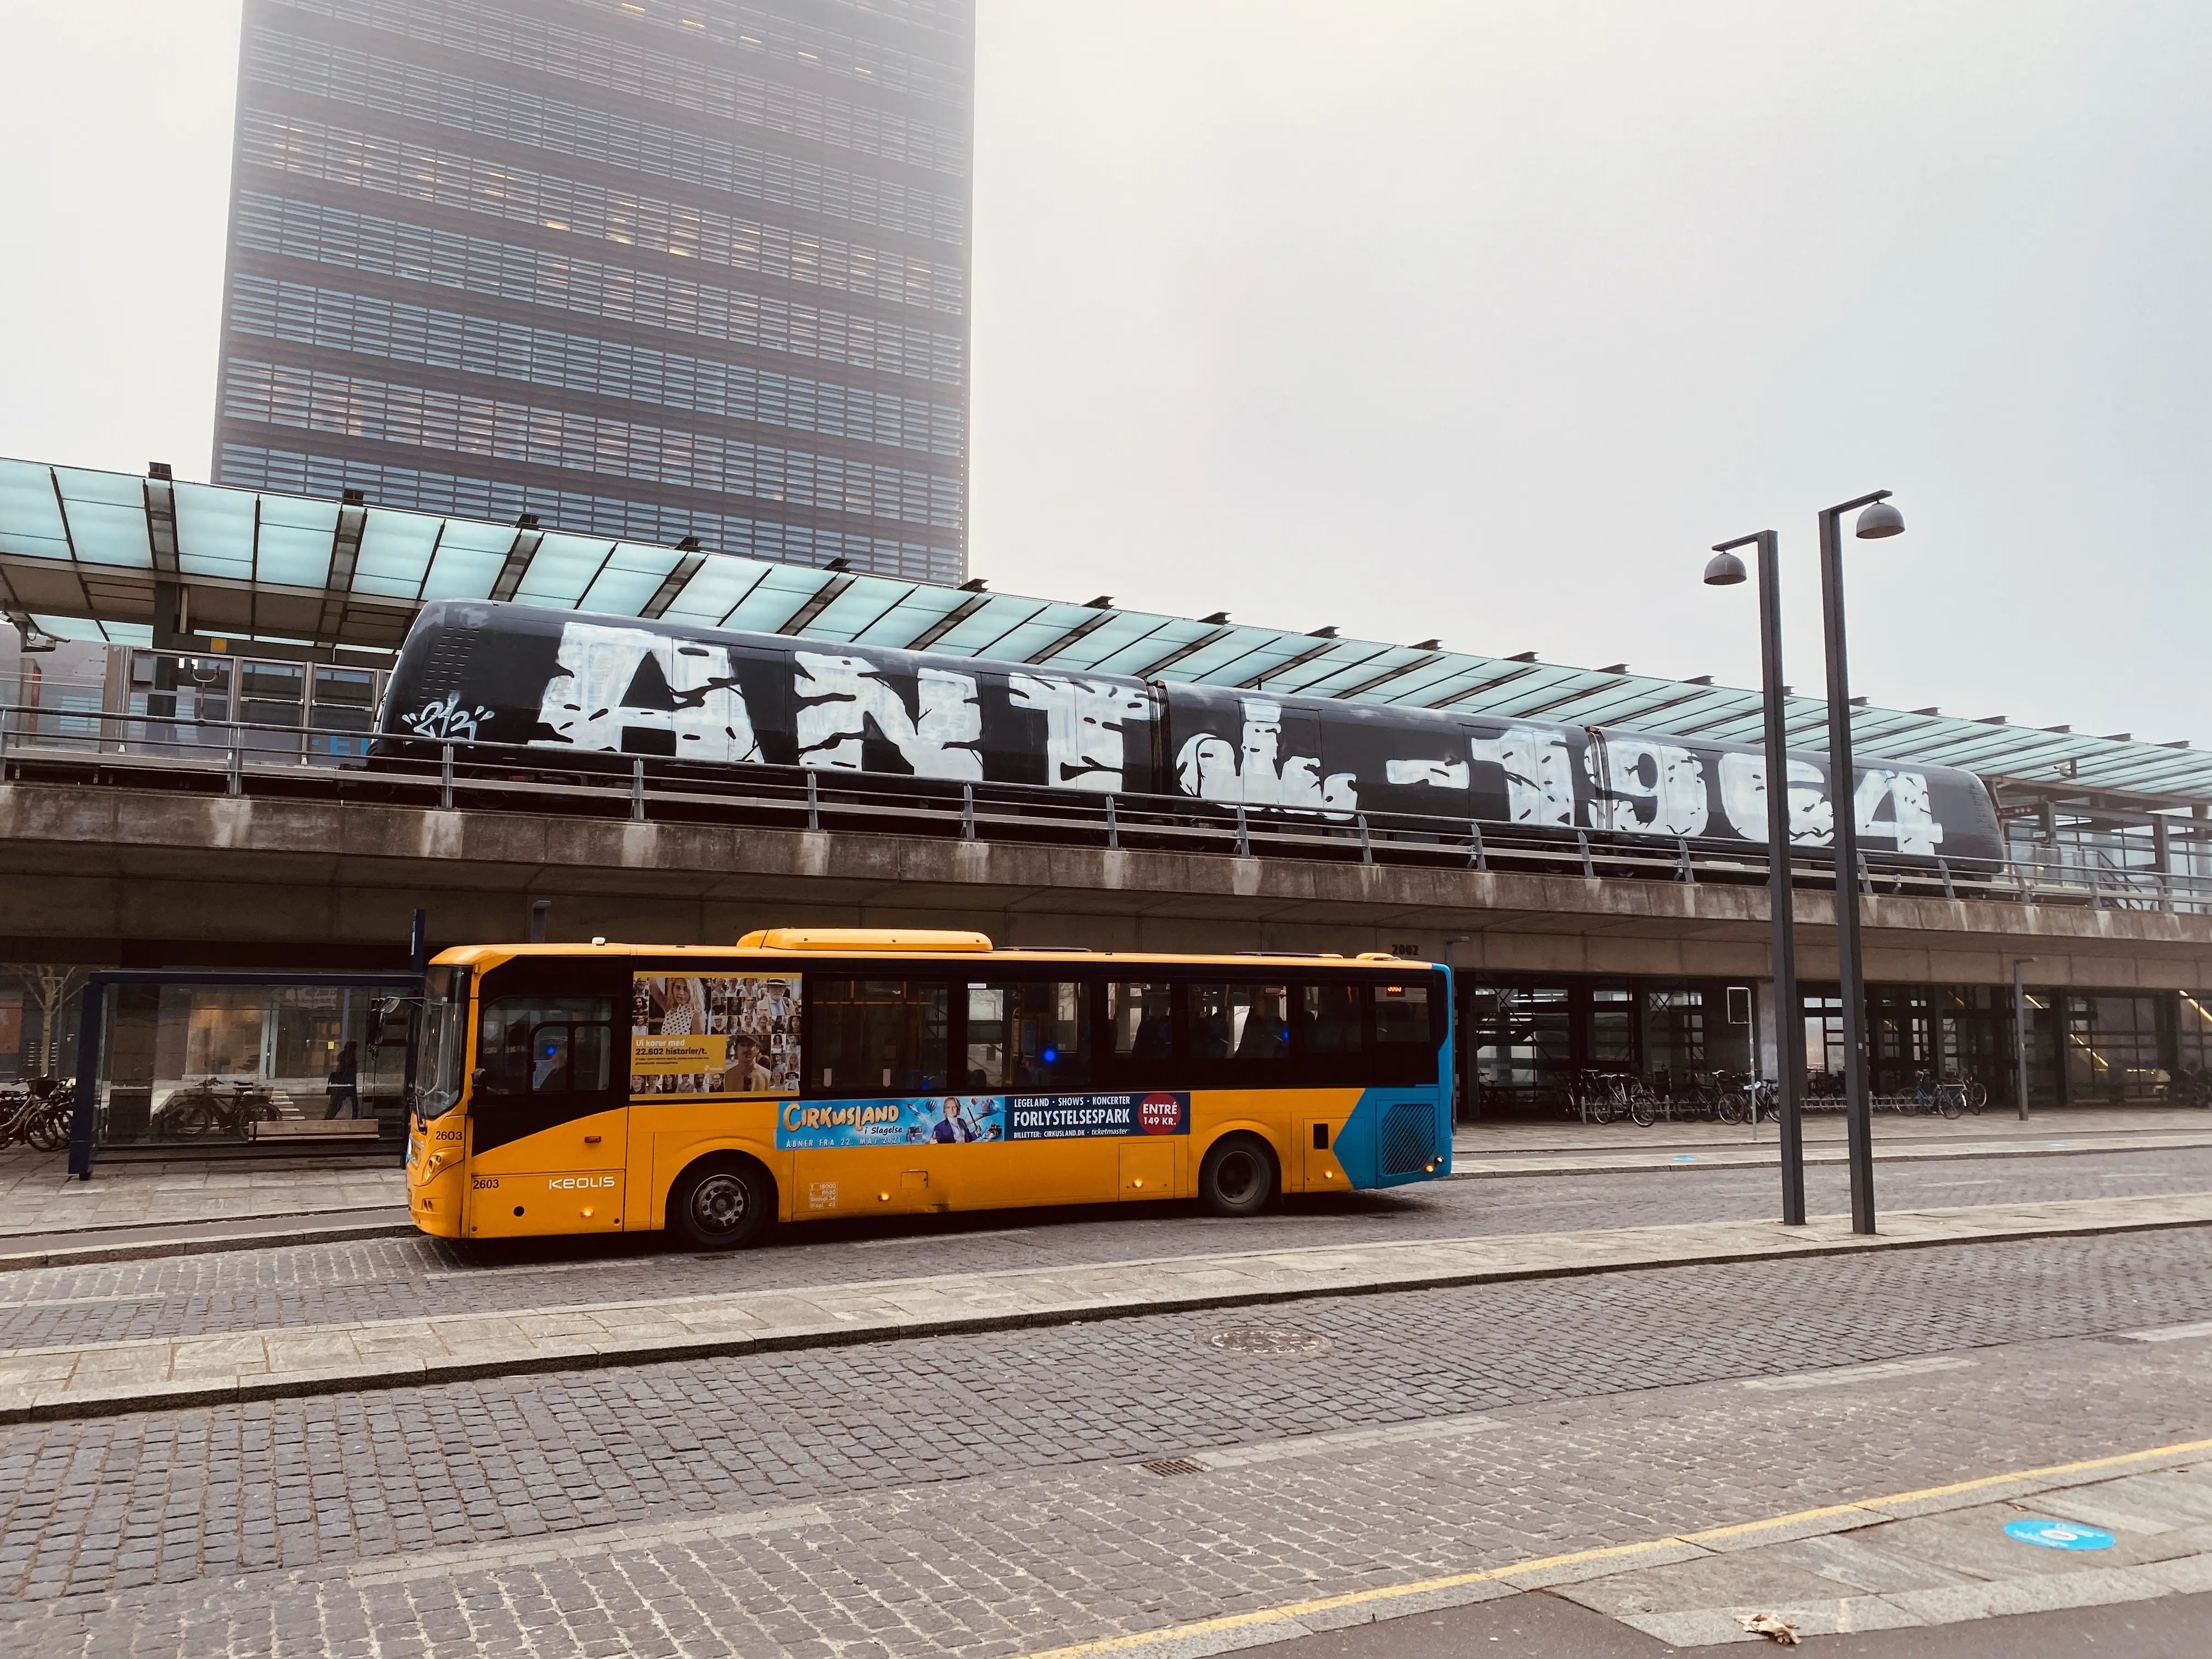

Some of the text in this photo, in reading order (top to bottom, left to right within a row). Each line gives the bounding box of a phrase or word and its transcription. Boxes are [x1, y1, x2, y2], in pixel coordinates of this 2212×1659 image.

[665, 1047, 707, 1056] historier/t.
[1014, 1096, 1130, 1108] LEGELAND SHOWS KONCERTER
[1142, 1101, 1178, 1115] ENTRÉ
[1014, 1108, 1131, 1127] FORLYSTELSESPARK
[1143, 1116, 1176, 1125] 149 KR.
[435, 1131, 463, 1141] 2603
[864, 1126, 902, 1136] i Slagelse
[1014, 1130, 1042, 1139] BILLETTER:
[1043, 1129, 1085, 1138] CIRKUSLAND.DK
[786, 1138, 814, 1148] ÅBNER
[840, 1138, 854, 1146] 22.
[859, 1137, 878, 1146] MAJ
[882, 1136, 901, 1144] 2021
[472, 1180, 499, 1189] 2603
